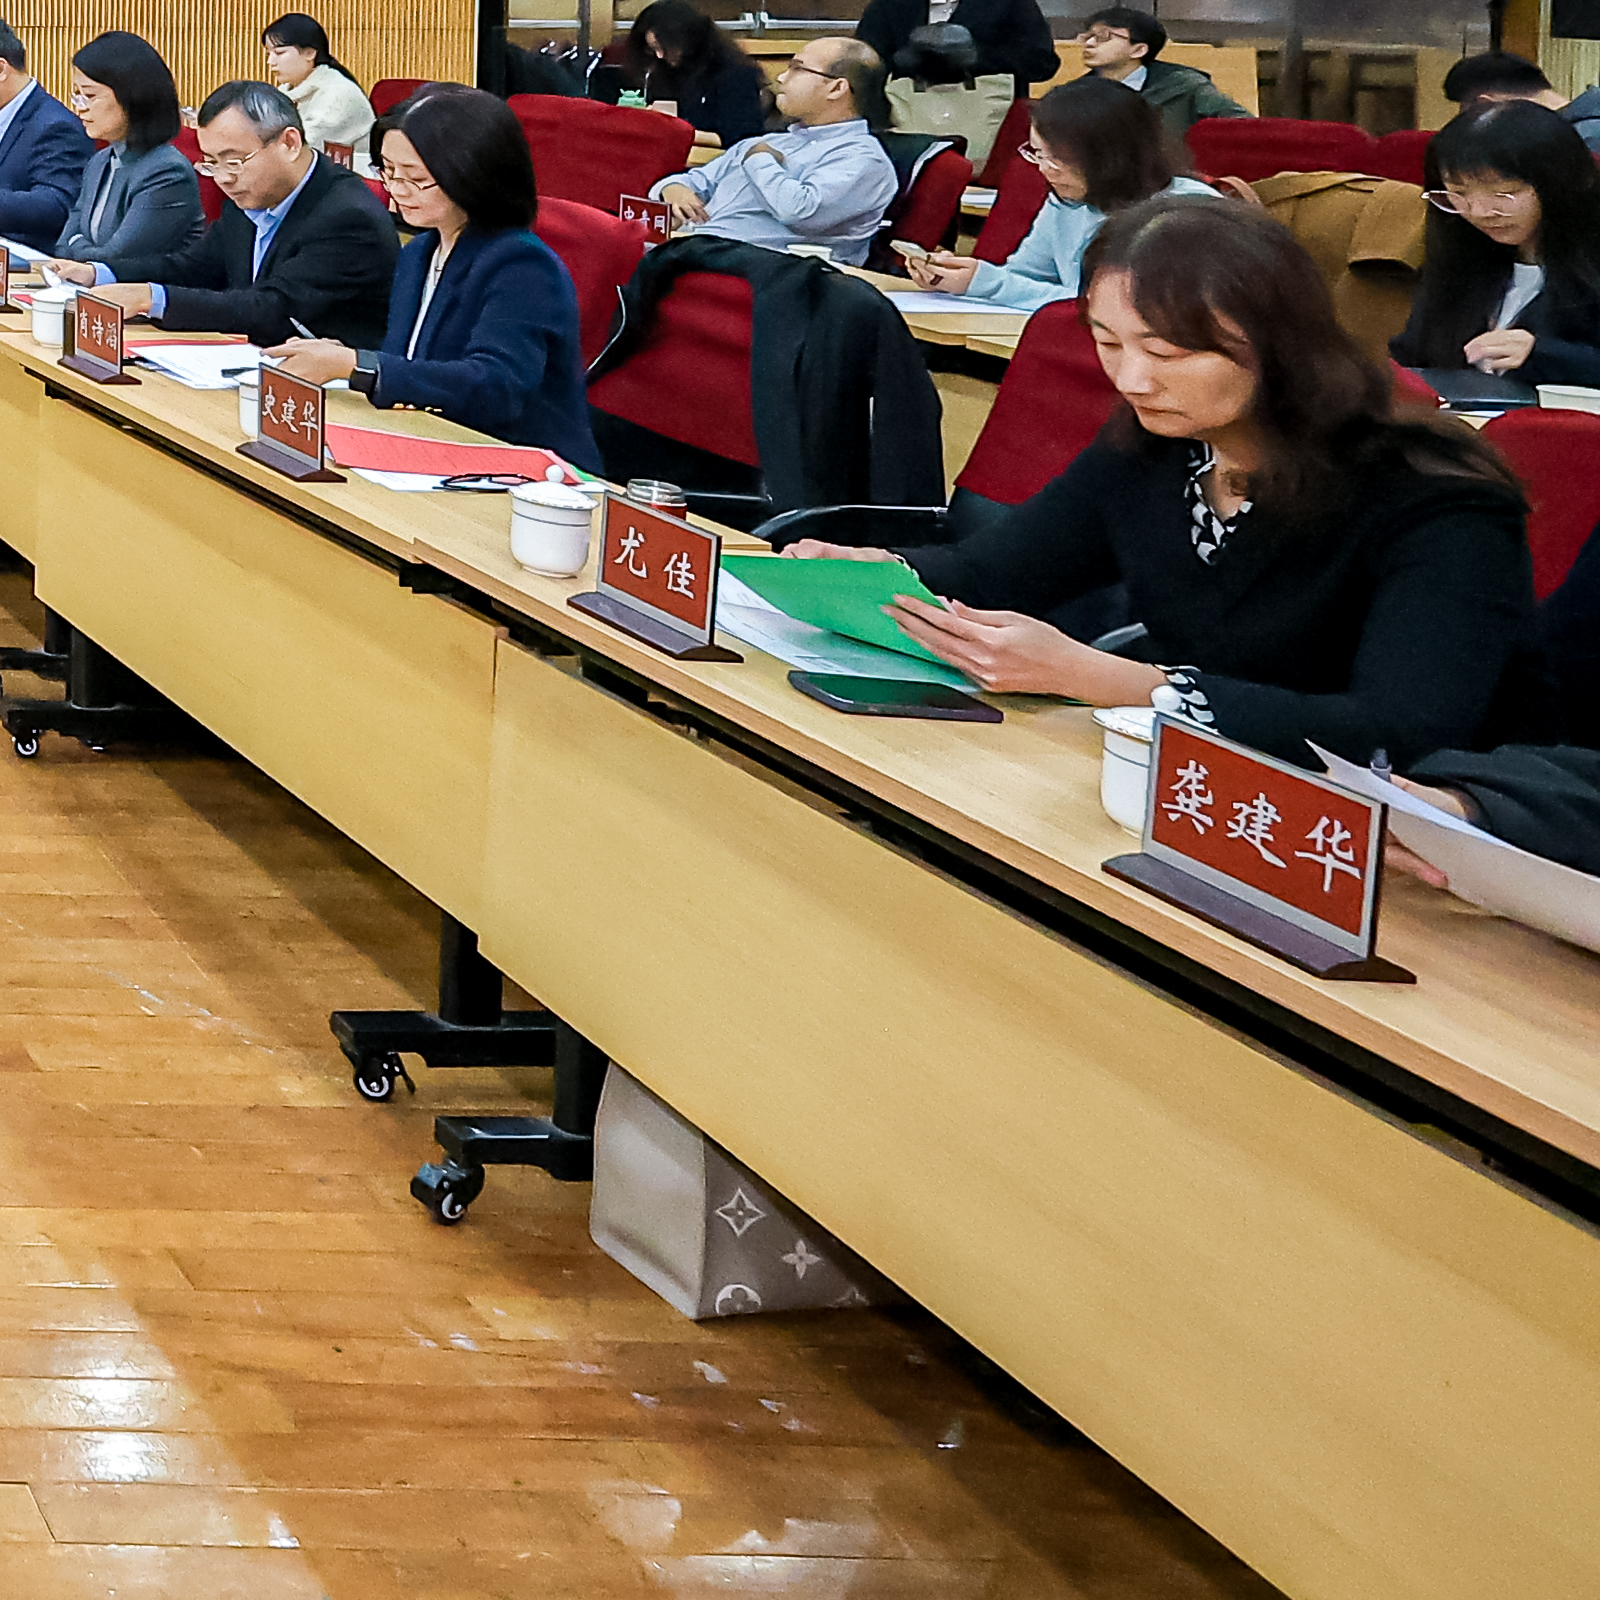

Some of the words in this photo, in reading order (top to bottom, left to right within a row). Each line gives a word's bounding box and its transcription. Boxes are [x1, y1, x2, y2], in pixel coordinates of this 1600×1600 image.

[261, 385, 319, 441] 史建华
[613, 526, 696, 599] 尤佳
[1161, 759, 1361, 893] 龚建华
